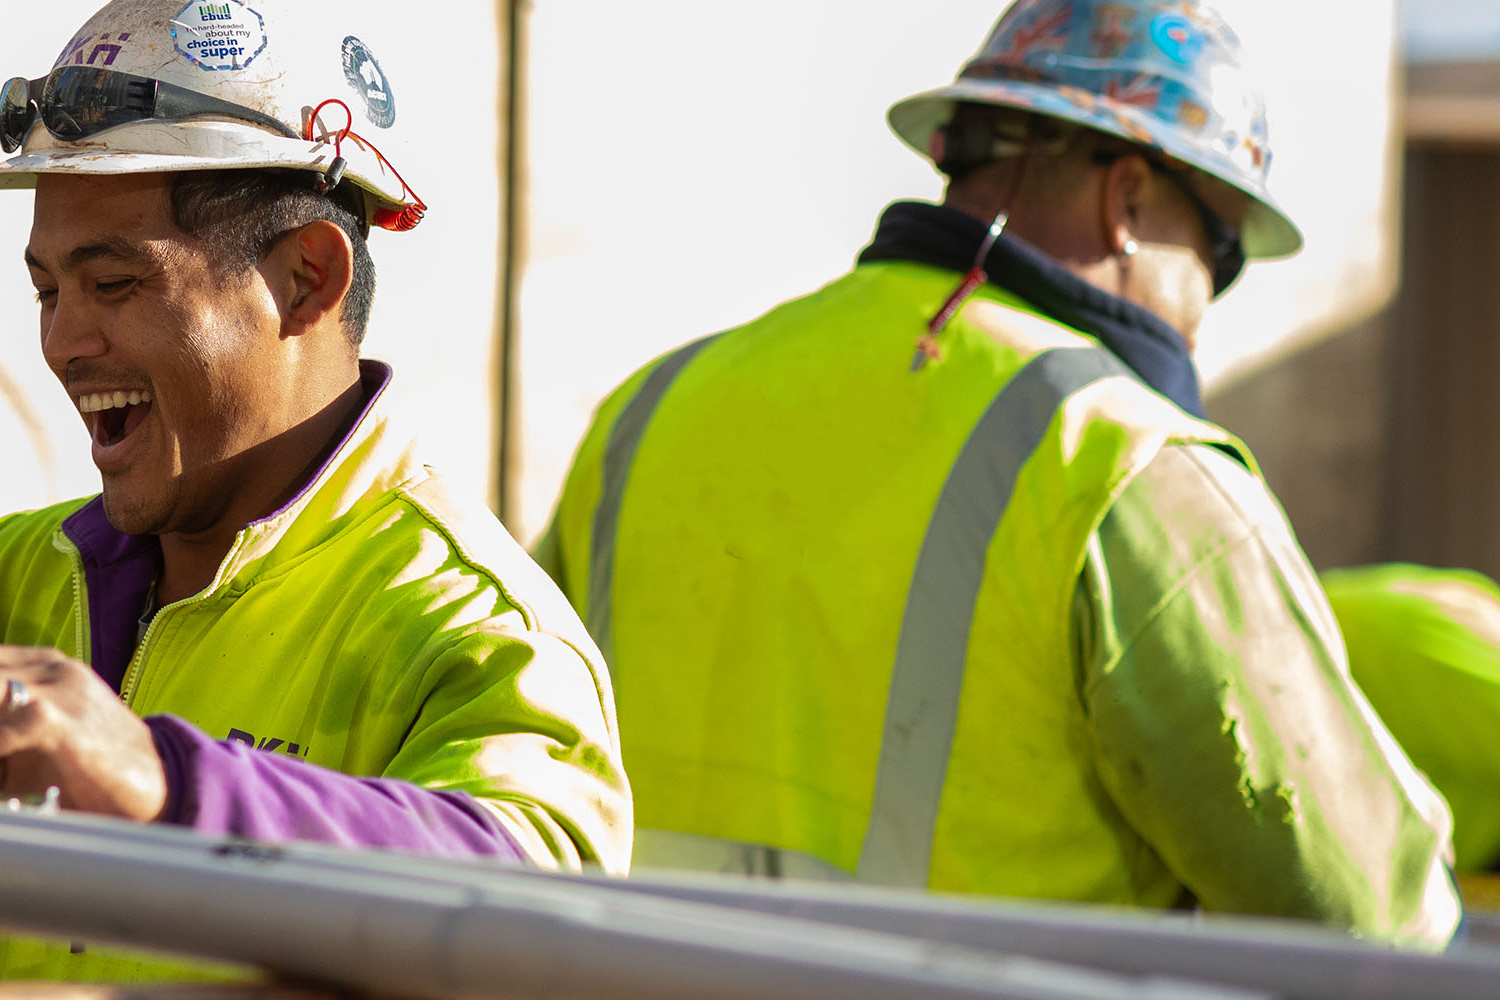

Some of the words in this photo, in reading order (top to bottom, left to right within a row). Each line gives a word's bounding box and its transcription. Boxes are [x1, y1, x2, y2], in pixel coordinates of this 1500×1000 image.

[201, 12, 232, 21] cbus
[205, 30, 234, 38] about
[187, 38, 225, 49] choice
[227, 37, 238, 46] in
[200, 47, 245, 59] super
